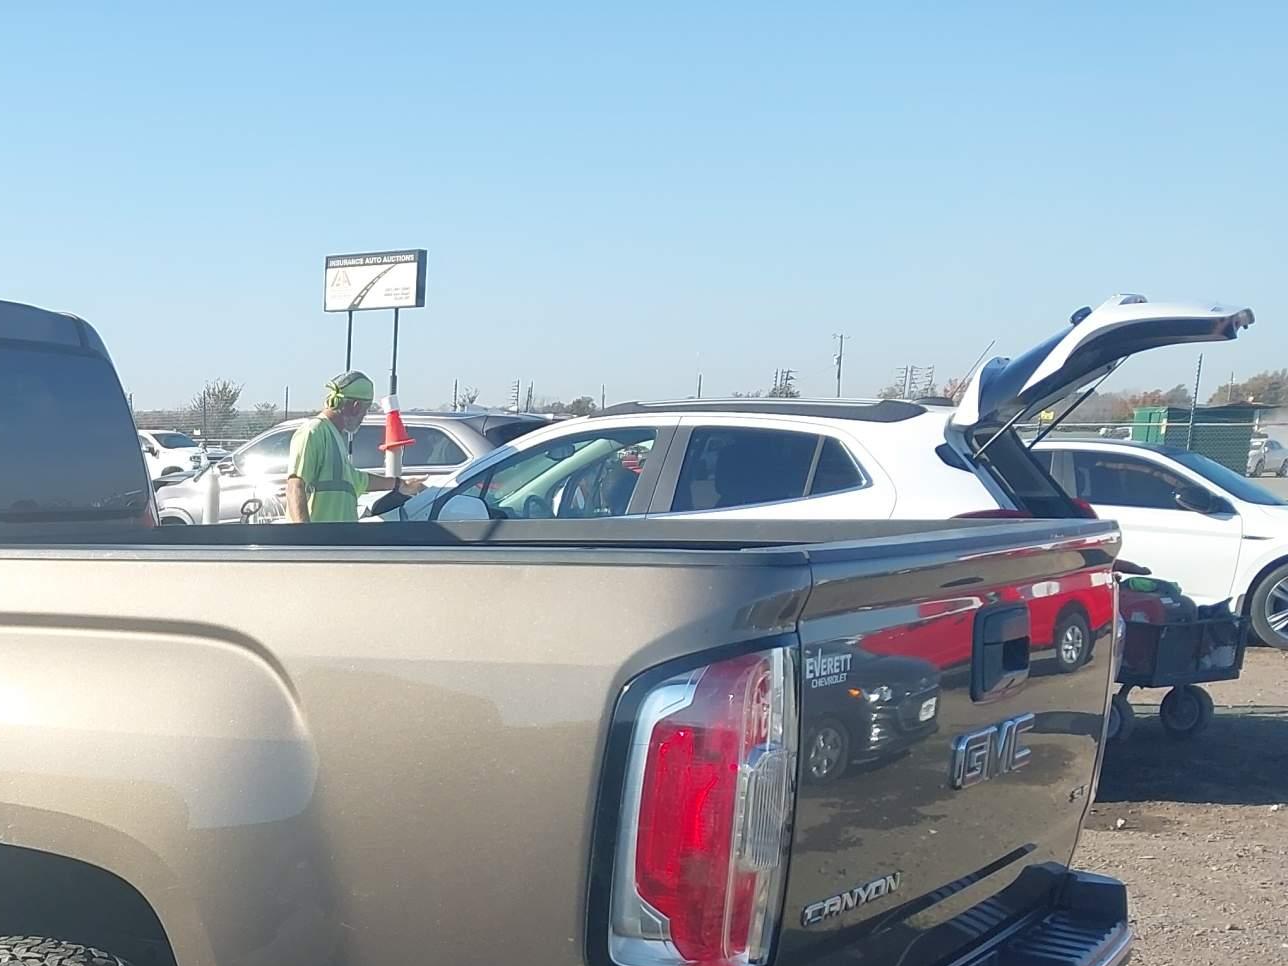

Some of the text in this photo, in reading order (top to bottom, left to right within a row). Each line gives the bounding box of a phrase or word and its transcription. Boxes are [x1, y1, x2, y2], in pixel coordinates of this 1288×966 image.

[329, 254, 415, 267] INSURANCE AUTO AUCTIONS
[805, 647, 852, 679] EVERETT
[812, 672, 848, 689] CHEVROLET
[951, 711, 1035, 790] GMC
[800, 872, 901, 927] CANYON
